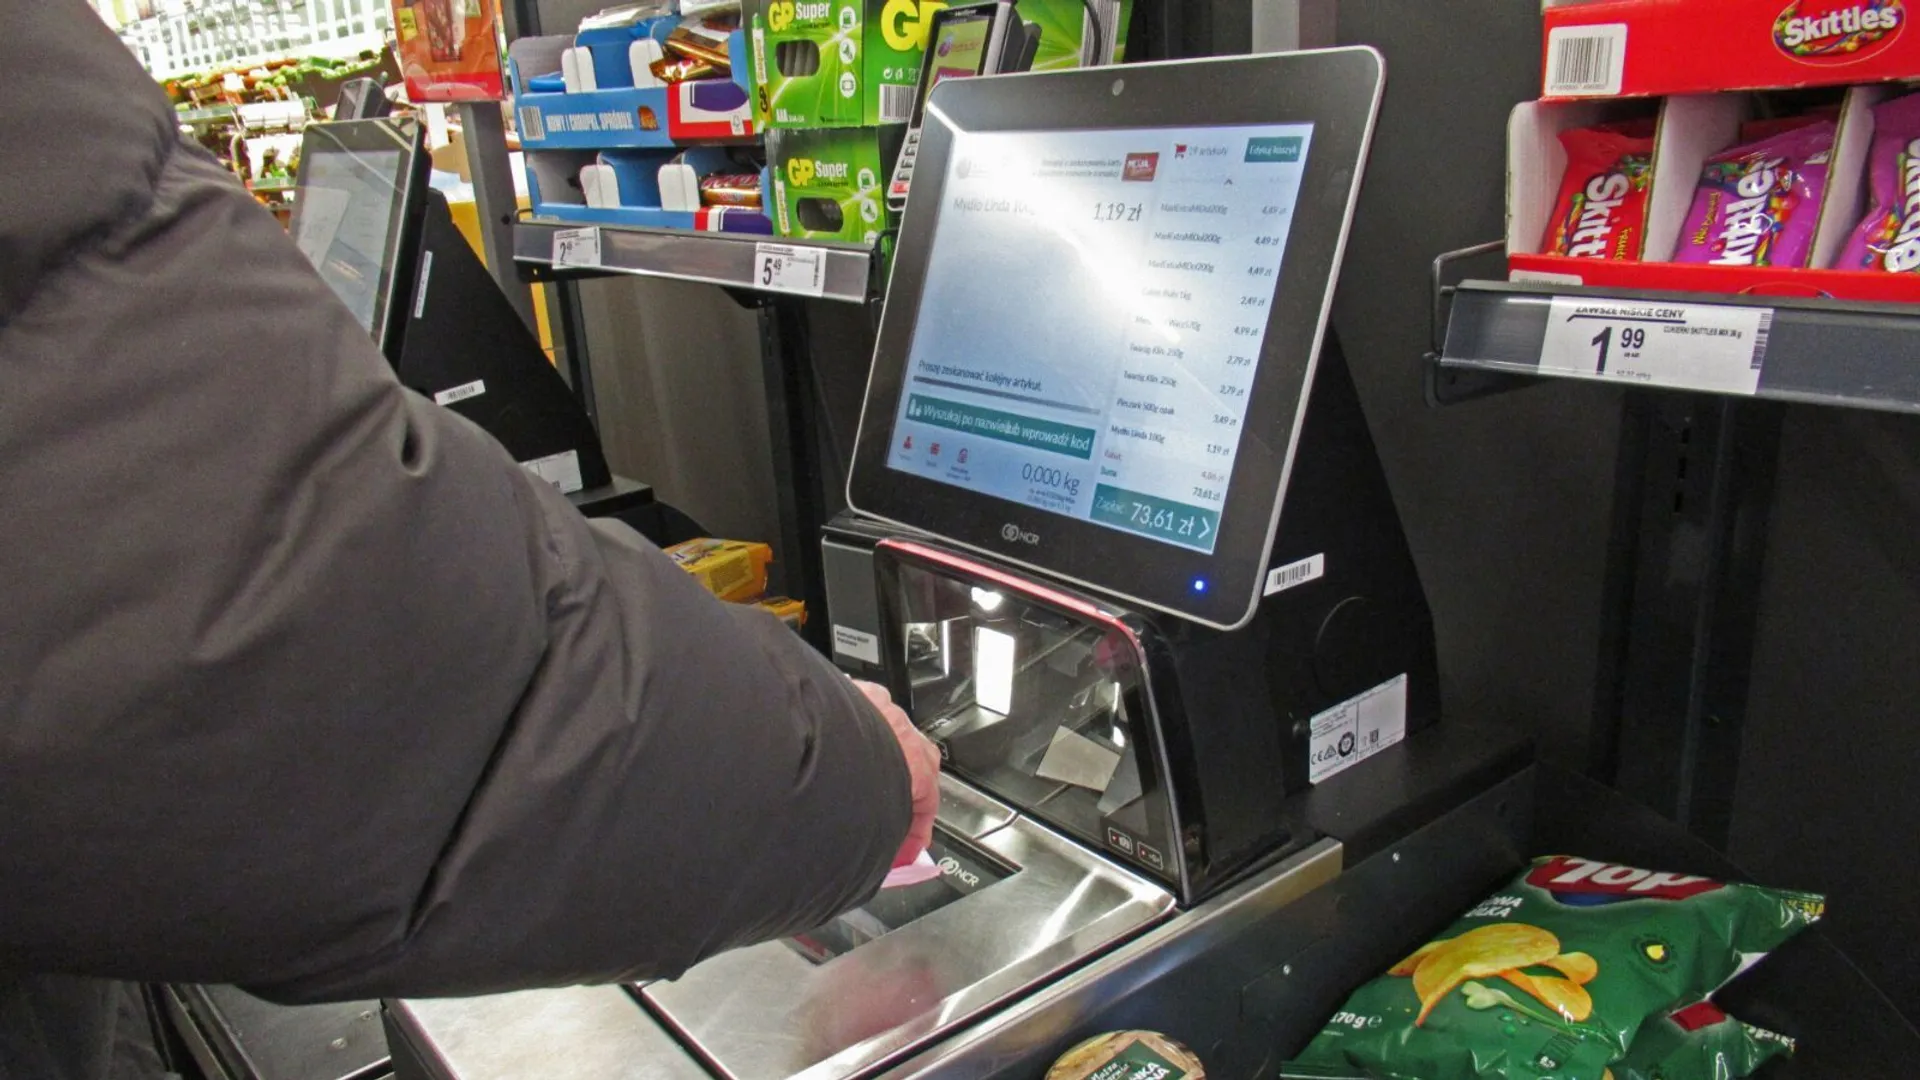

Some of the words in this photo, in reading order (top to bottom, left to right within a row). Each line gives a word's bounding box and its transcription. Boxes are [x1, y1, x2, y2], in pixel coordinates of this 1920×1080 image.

[768, 1, 795, 32] GP
[796, 0, 831, 21] Super
[1784, 6, 1897, 46] Skittles
[787, 157, 815, 187] GP
[815, 160, 848, 181] Super
[985, 200, 1010, 213] Linda
[1093, 202, 1125, 223] 1,19
[1127, 203, 1143, 222] zł
[1568, 174, 1629, 259] Skitt
[763, 257, 773, 286] 5
[1655, 308, 1685, 318] CENY
[1690, 326, 1717, 336] SKITTLES
[1591, 326, 1613, 375] 1
[1621, 327, 1646, 350] 99
[918, 359, 941, 375] Proszę
[941, 365, 984, 382] zeskanować
[985, 371, 1012, 388] kolejny
[923, 403, 961, 425] Wyszukaj
[961, 415, 974, 427] po
[1022, 425, 1069, 447] wprowadź
[1071, 434, 1091, 452] kod
[1022, 462, 1062, 488] 0,000
[1064, 471, 1080, 497] kg
[1131, 502, 1174, 532] 73,61
[1178, 515, 1195, 536] zł
[1019, 531, 1040, 546] NCR
[954, 868, 980, 888] NCR
